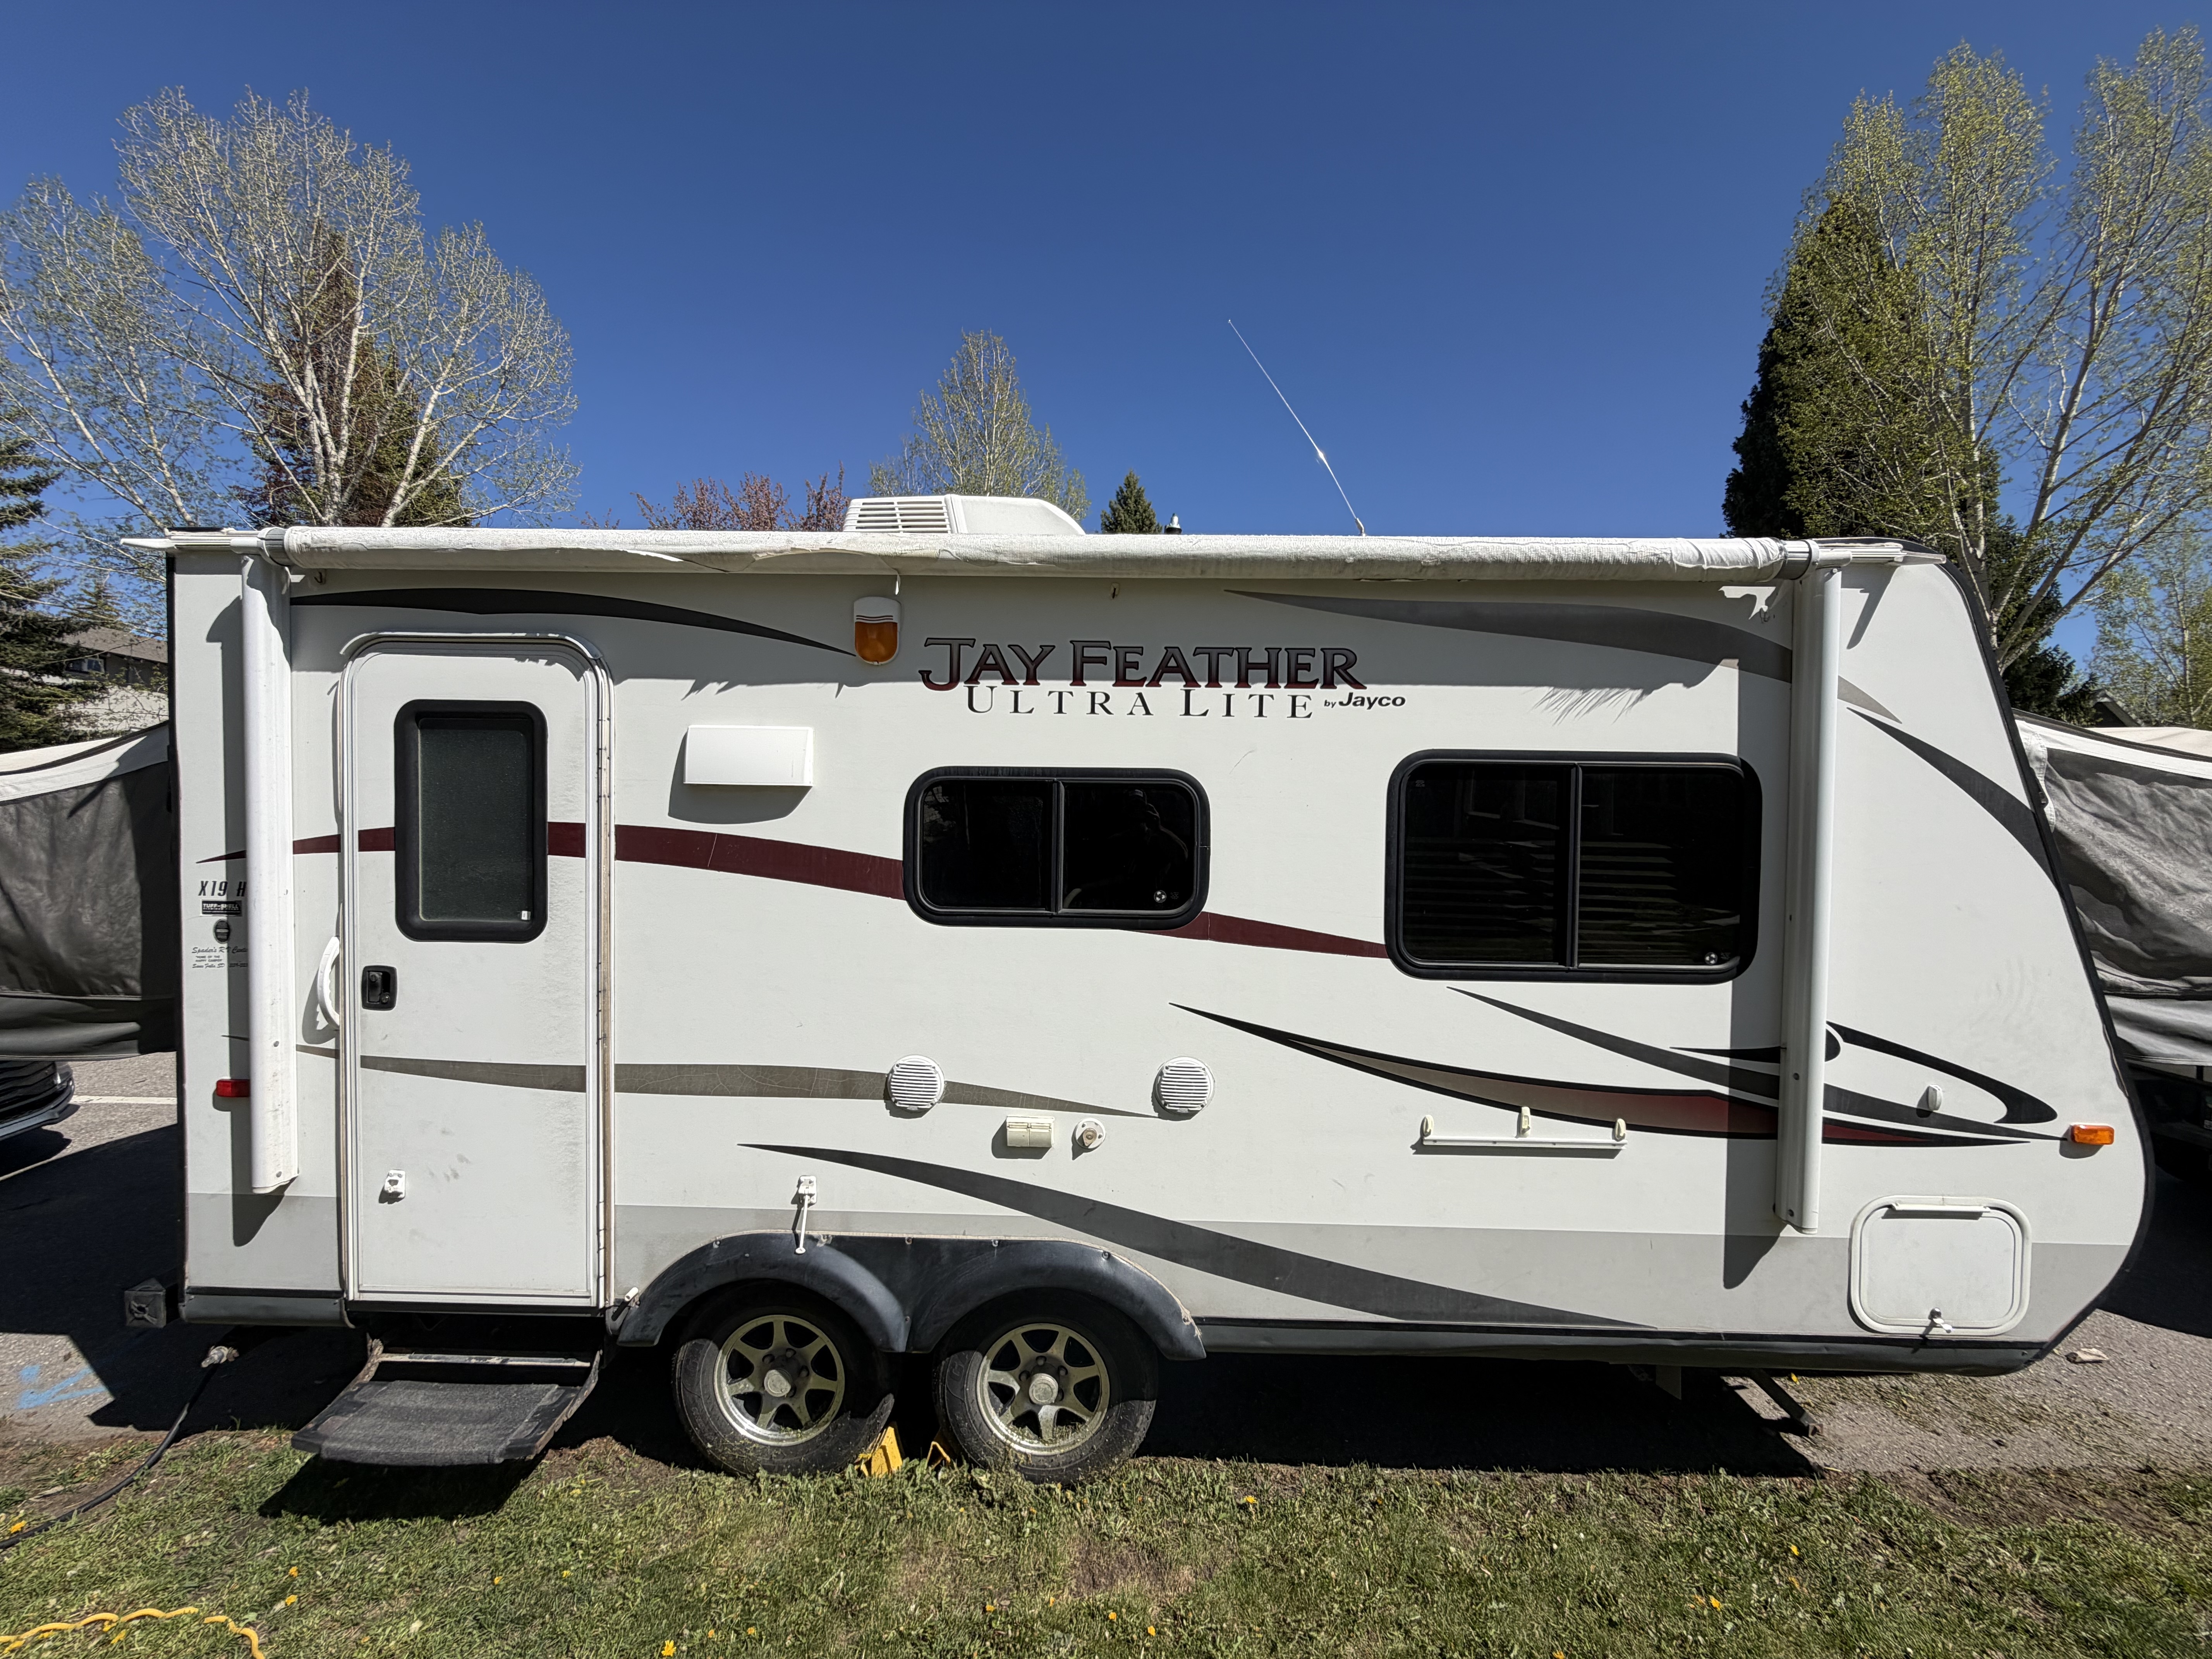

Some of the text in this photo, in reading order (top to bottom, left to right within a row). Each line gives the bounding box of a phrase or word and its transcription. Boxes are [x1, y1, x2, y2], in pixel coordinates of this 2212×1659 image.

[918, 637, 1367, 691] JAY FEATHER
[963, 685, 1313, 719] ULTRA LITE
[1324, 692, 1406, 710] by Jayco
[198, 881, 228, 896] X19
